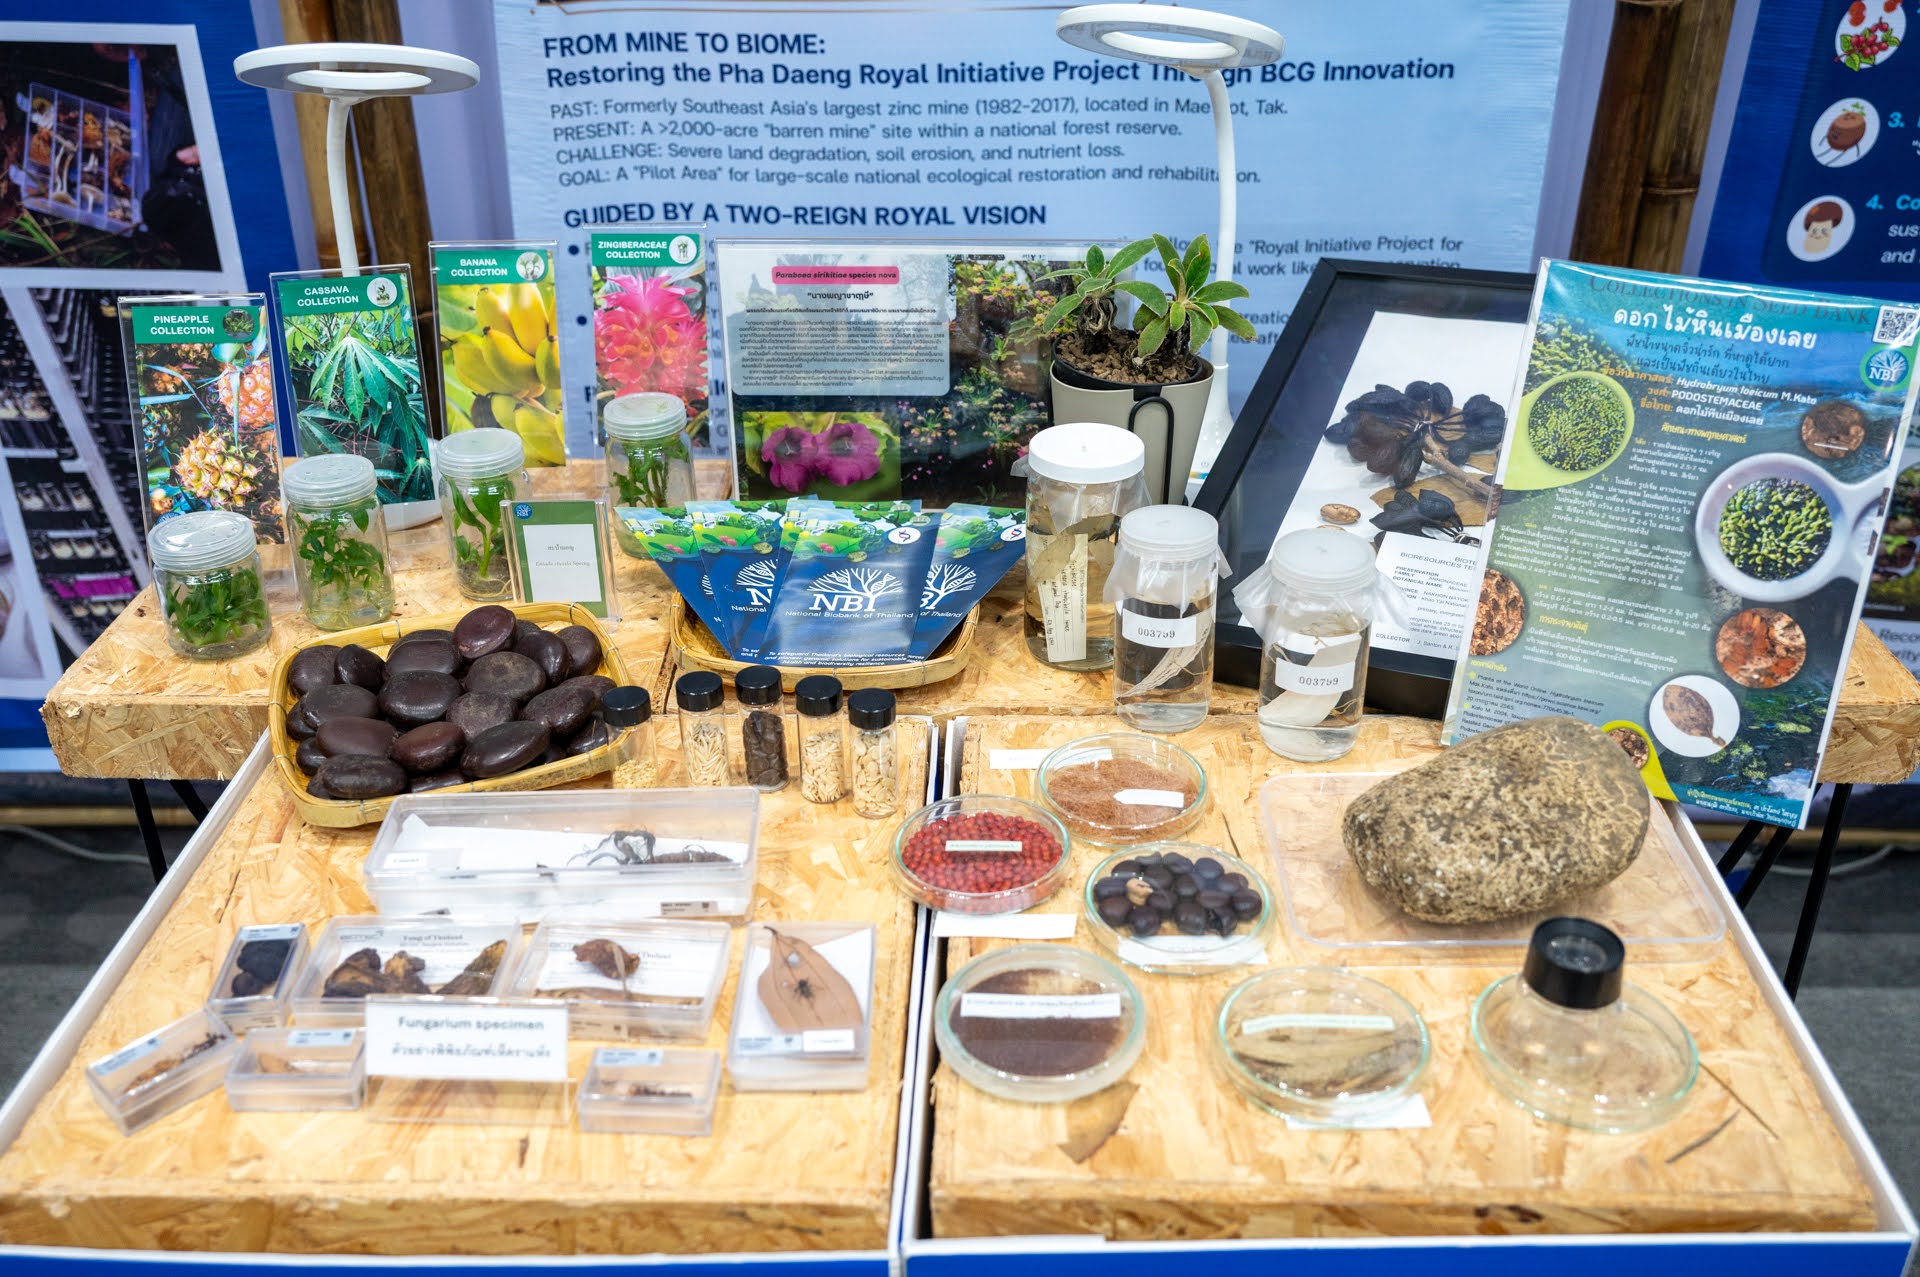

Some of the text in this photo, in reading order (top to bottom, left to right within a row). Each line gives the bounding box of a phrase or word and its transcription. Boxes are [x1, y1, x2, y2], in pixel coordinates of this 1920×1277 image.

[543, 32, 826, 58] FROM MINE TO BIOME:
[547, 62, 665, 88] Restoring
[673, 62, 711, 84] the
[719, 63, 765, 85] Pha
[772, 64, 851, 89] Daeng
[860, 64, 928, 88] Royal
[936, 61, 1045, 85] Initiative
[1053, 60, 1140, 86] Project
[1260, 61, 1315, 83] BCG
[1323, 59, 1455, 82] Innovation
[551, 102, 599, 119] PAST:
[604, 98, 677, 117] Formerly
[682, 98, 764, 116] Southeast
[770, 98, 818, 116] Asia's
[824, 99, 881, 121] largest
[888, 100, 923, 116] zinc
[928, 100, 969, 116] mine
[1085, 97, 1149, 115] located
[1154, 97, 1169, 113] in
[1175, 98, 1211, 114] Mae
[1229, 101, 1249, 116] ot,
[1256, 99, 1288, 115] Tak.
[1887, 111, 1905, 128] 3.
[553, 120, 1182, 142] PRESENT: A >2,000-acre "barren mine" site within a national forest reserve.
[556, 142, 1125, 166] CHALLENGE: Severe land degradation, soil erosion, and nutrient loss.
[559, 164, 1261, 188] GOAL: A "Pilot Area" for large-scale national ecological restoration and rehabiliton.
[1865, 194, 1884, 210] 4.
[564, 202, 1046, 229] GUIDED BY A TWO-REIGN ROYAL VISION
[598, 241, 668, 249] ZINGIBERACEAE
[1249, 236, 1463, 256] "Royal Initiative Project for
[459, 257, 498, 267] BANANA
[605, 250, 661, 259] COLLECTION
[1880, 249, 1916, 264] and
[450, 267, 508, 278] COLLECTION
[849, 272, 877, 281] species
[878, 272, 897, 280] nova
[1248, 262, 1286, 276] work
[303, 285, 350, 297] CASSAVA
[297, 295, 359, 307] COLLECTION
[153, 314, 209, 326] PINEAPPLE
[150, 325, 215, 336] COLLECTION
[1676, 377, 1739, 395] Hydrobryum
[1780, 391, 1818, 406] M.Kato
[1671, 390, 1763, 412] PODOSTEMACEAE
[1400, 552, 1462, 569] BIORESOURCES
[731, 605, 767, 613] National
[785, 610, 821, 618] National
[824, 611, 860, 619] Biobank
[930, 610, 963, 618] Thailand
[1375, 632, 1411, 644] COLLECTOR
[398, 1015, 544, 1034] Fungarium specimen
